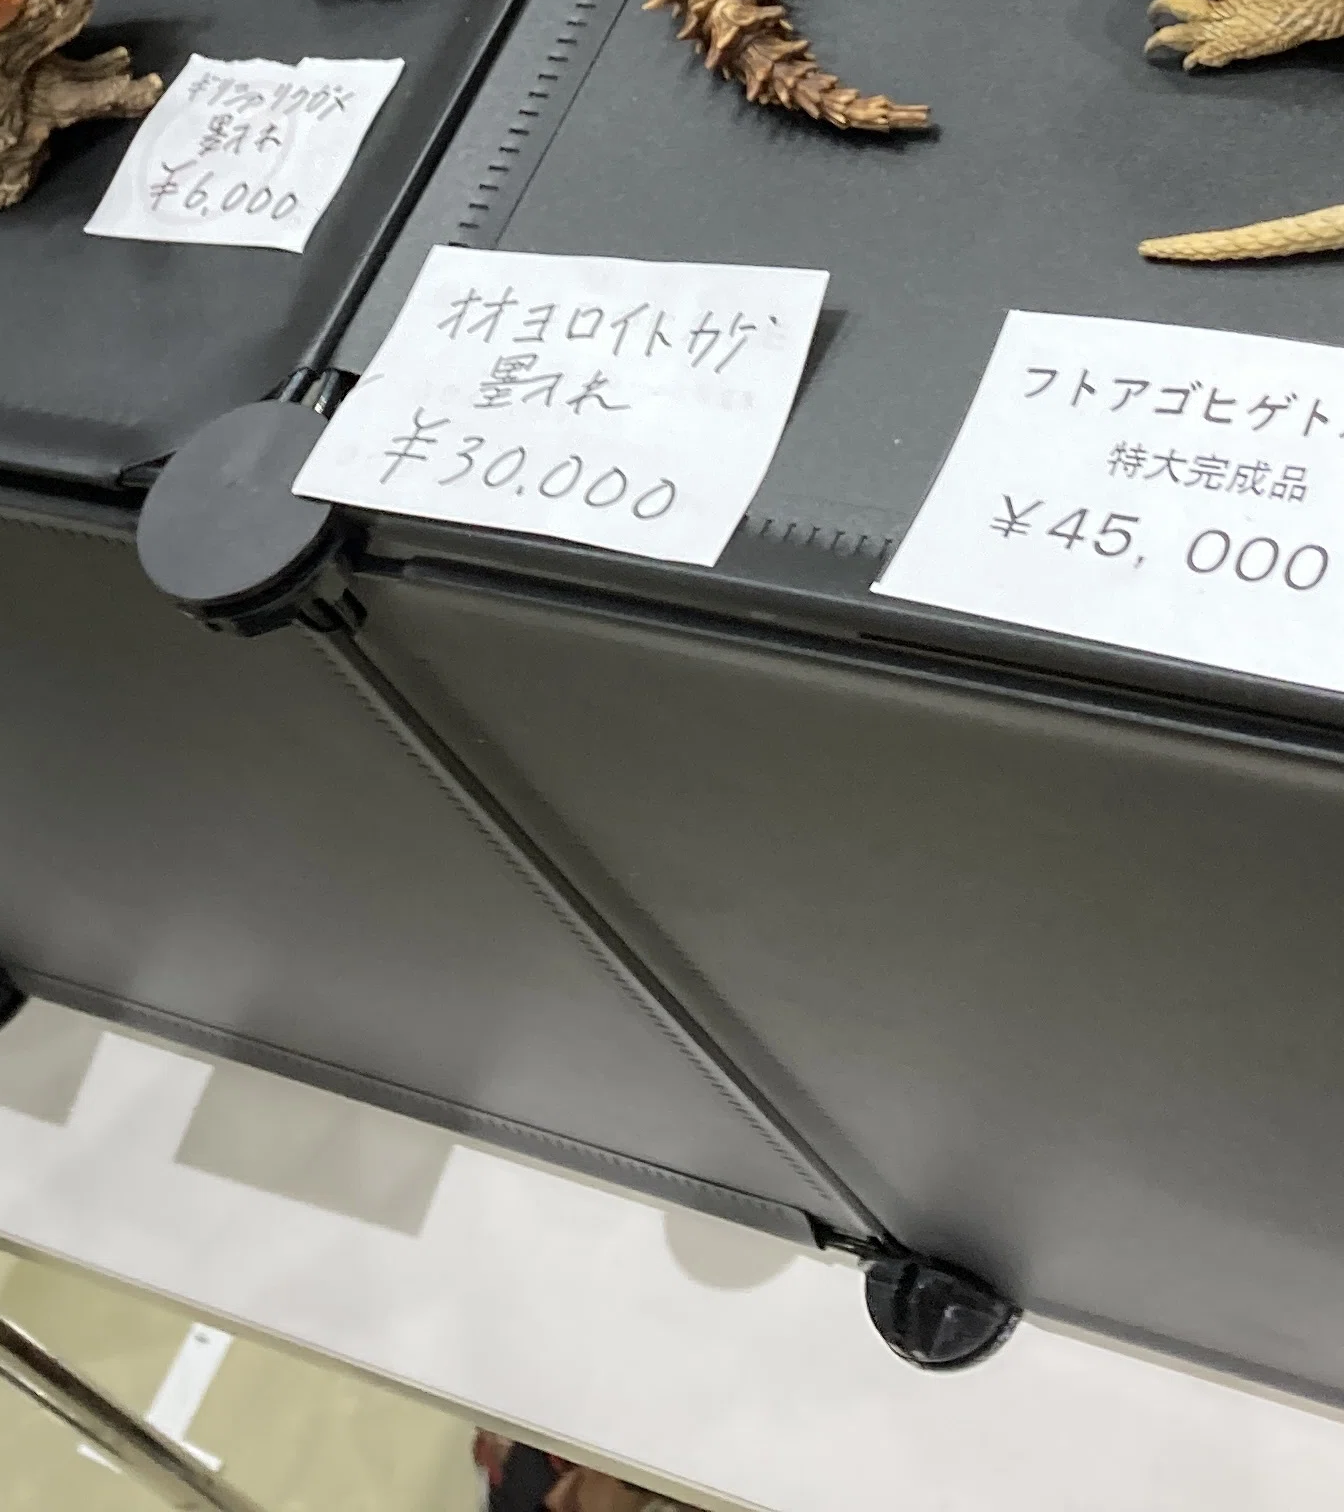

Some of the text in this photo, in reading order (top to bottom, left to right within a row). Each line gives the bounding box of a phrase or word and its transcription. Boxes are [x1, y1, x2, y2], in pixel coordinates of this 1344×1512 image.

[436, 285, 781, 375] オオヨロイトカゲ
[1105, 439, 1310, 503] 特大完成品
[989, 493, 1331, 592] ¥45,000
